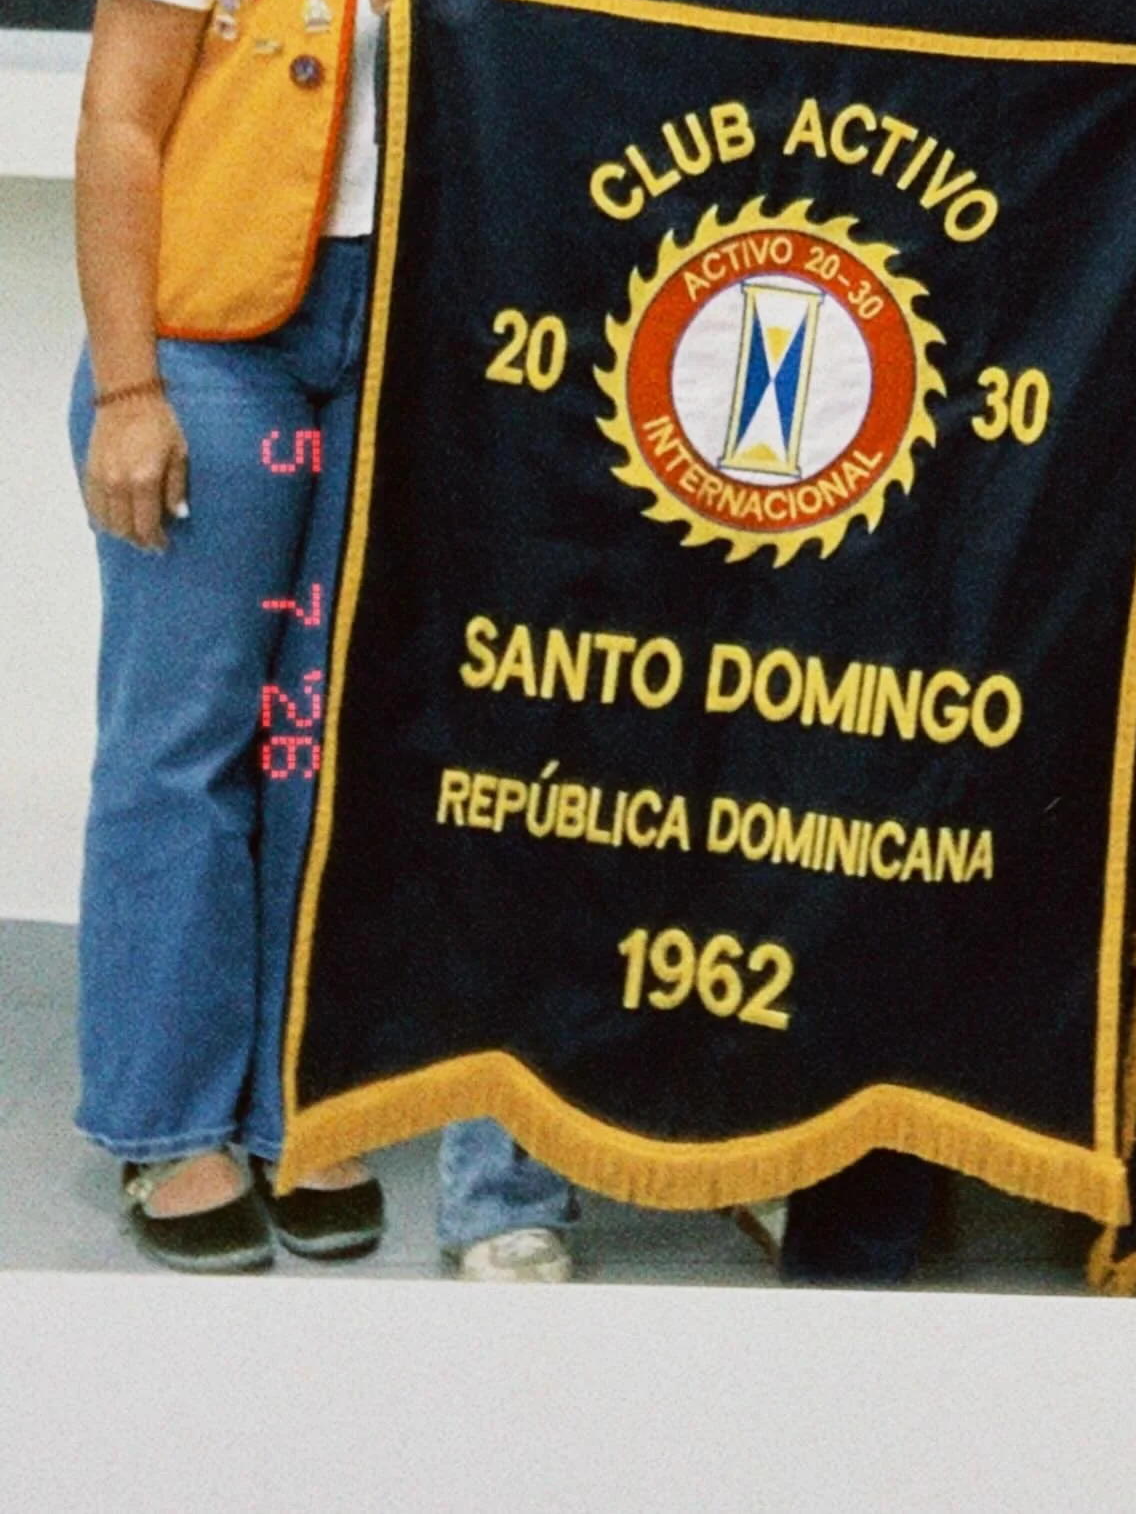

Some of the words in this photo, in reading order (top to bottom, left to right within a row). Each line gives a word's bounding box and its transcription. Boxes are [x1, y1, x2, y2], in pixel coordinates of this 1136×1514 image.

[589, 101, 756, 221] CLUB
[783, 97, 999, 244] ACTIVO
[681, 237, 793, 302] ACTIVO
[804, 246, 885, 321] 20-30
[485, 308, 567, 391] 20
[971, 366, 1051, 445] 30
[643, 415, 884, 521] INTERNACIONAL
[459, 615, 683, 710] SANTO
[705, 643, 1022, 748] DOMINGO
[436, 759, 691, 853] REPÚBLICA
[706, 797, 994, 884] DOMINICANA
[617, 928, 794, 1031] 1962
